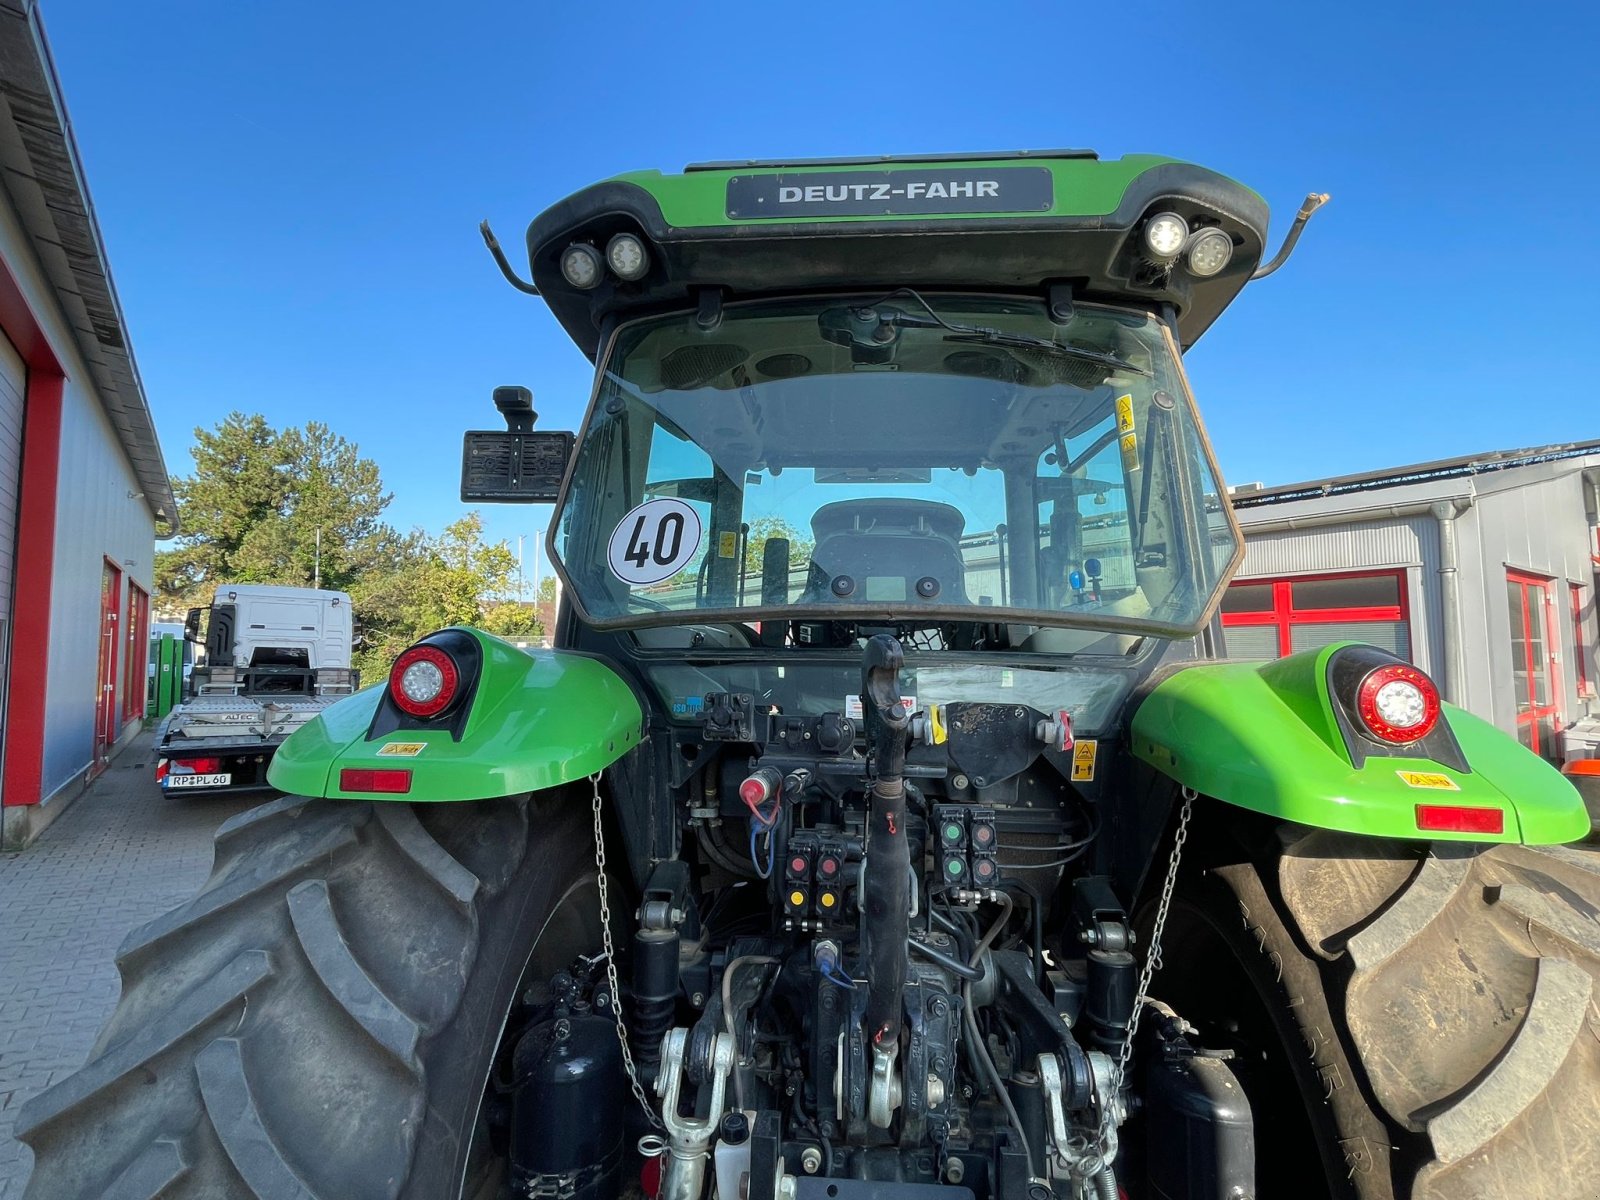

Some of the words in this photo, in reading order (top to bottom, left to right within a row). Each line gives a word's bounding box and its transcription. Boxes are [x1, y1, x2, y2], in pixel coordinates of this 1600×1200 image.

[778, 181, 999, 203] DEUTZ-FAHR
[624, 512, 685, 568] 40
[173, 776, 189, 786] RP
[196, 776, 210, 785] PL
[213, 775, 227, 784] 60
